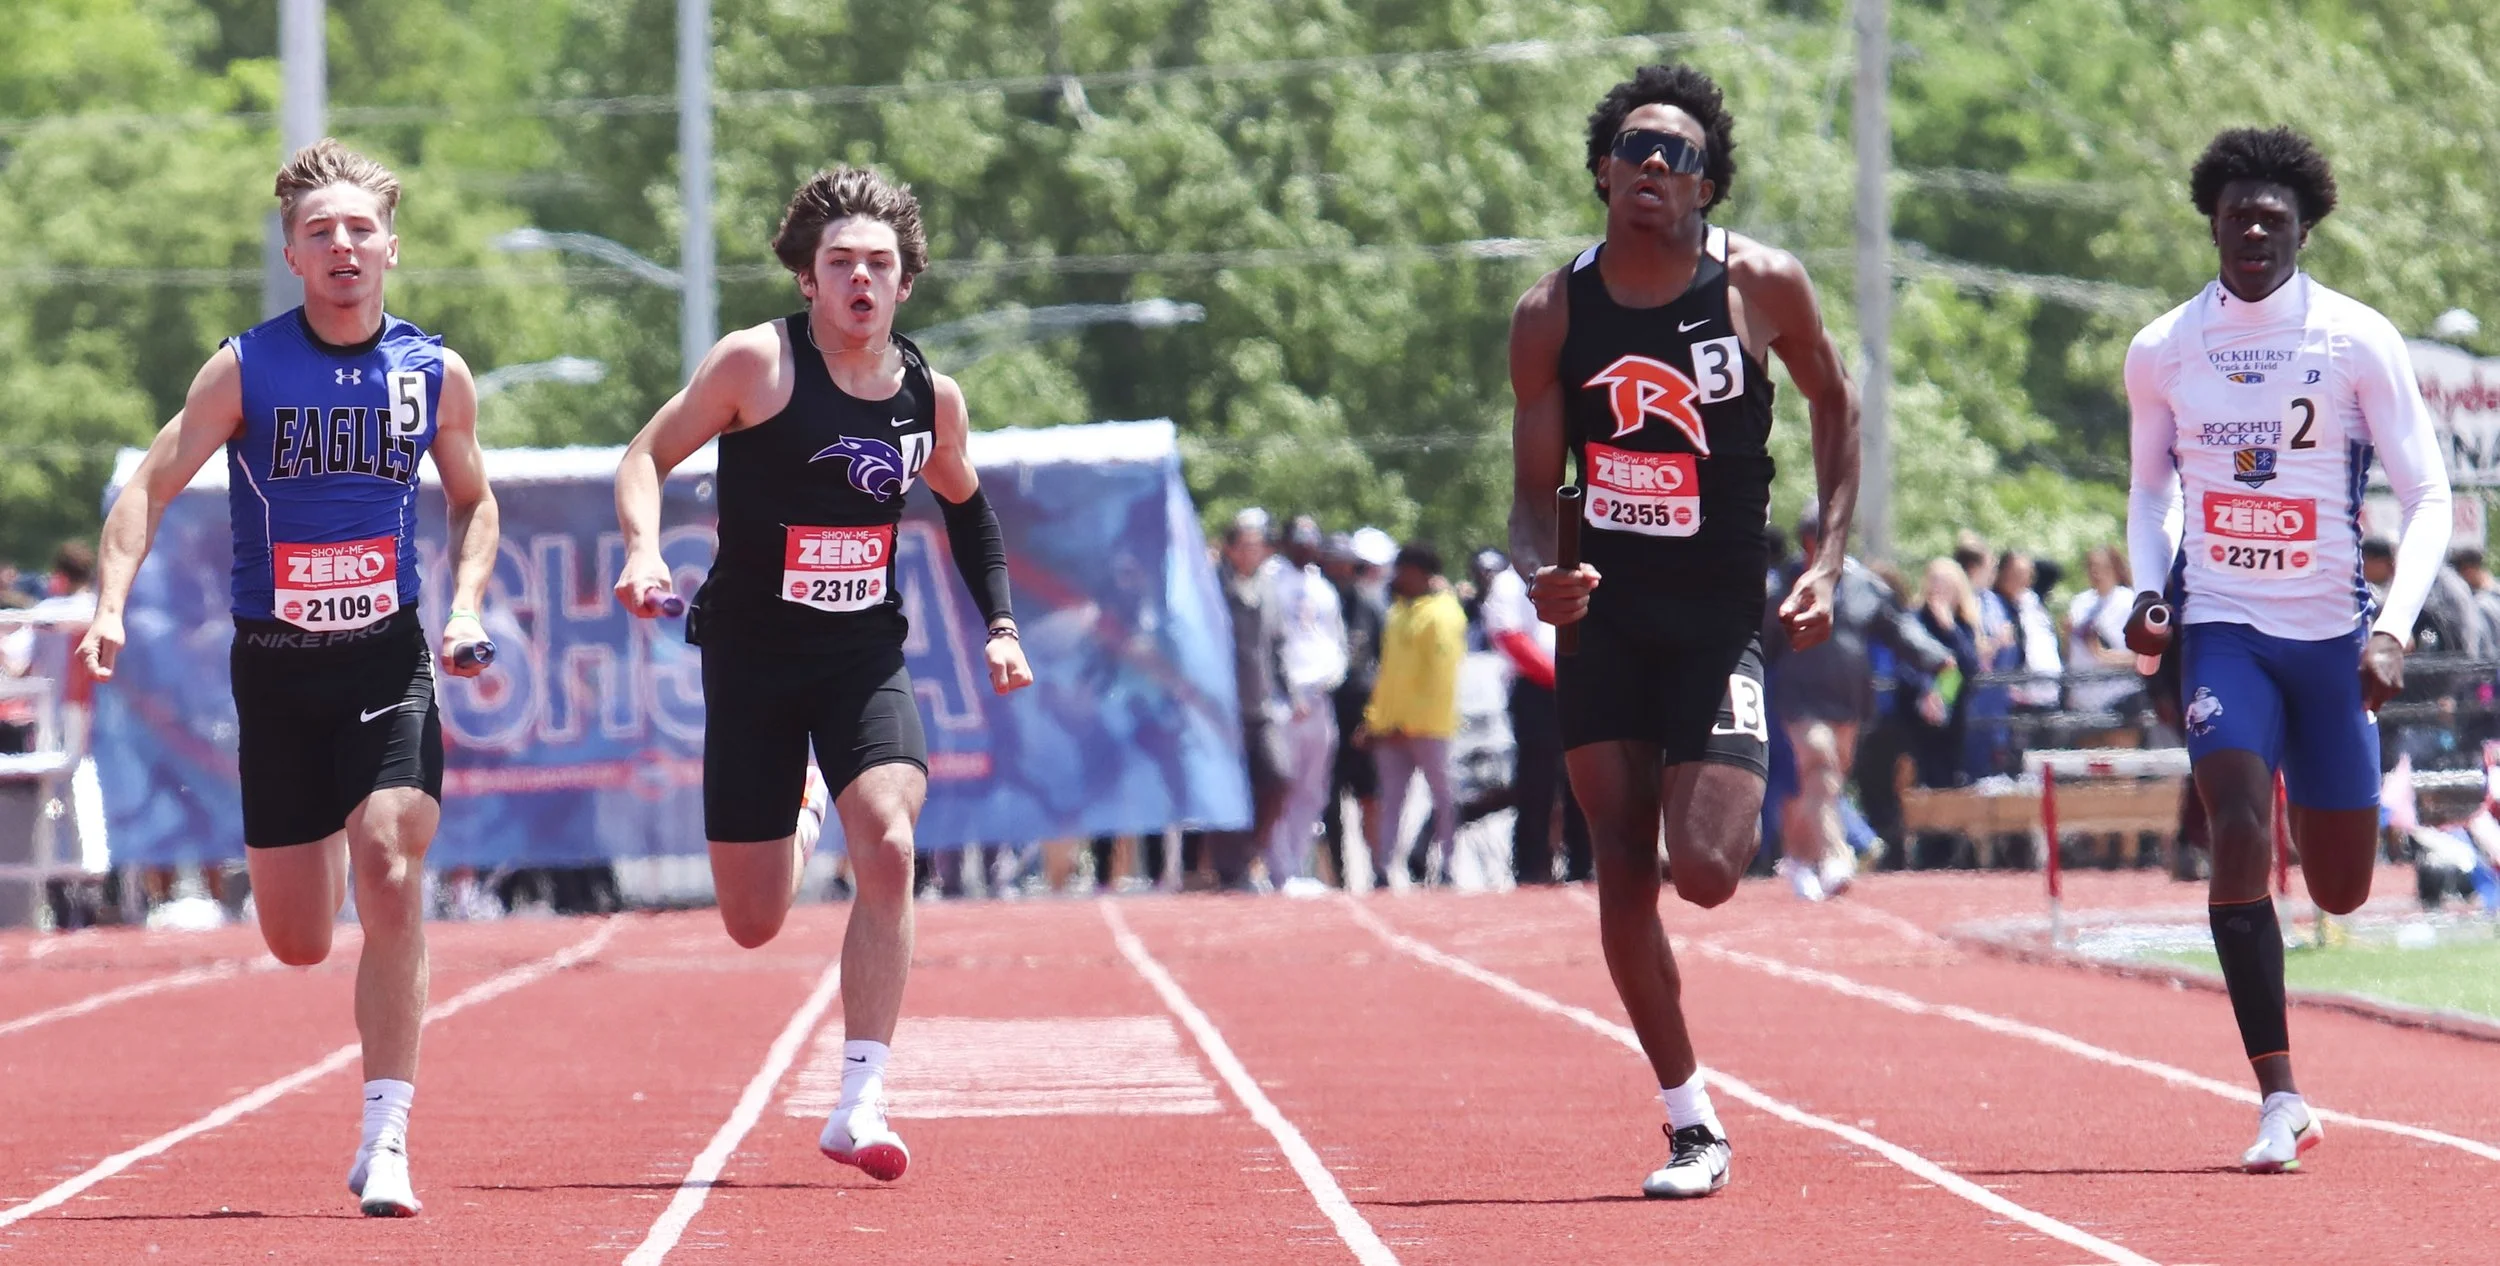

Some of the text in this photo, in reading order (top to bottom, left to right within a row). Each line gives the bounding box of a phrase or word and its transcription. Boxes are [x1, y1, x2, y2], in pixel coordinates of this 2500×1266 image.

[2209, 350, 2294, 364] OCKHURST
[2254, 362, 2278, 371] Field
[1702, 343, 1733, 399] 3
[398, 376, 420, 432] 5
[2290, 397, 2317, 450] 2
[267, 406, 417, 485] EAGLES
[2196, 433, 2249, 446] TRACK
[2254, 434, 2266, 445] &
[1611, 451, 1659, 466] SHOW-ME
[1595, 456, 1684, 490] ZERO
[1610, 500, 1670, 526] 2355
[2231, 499, 2283, 511] SHOW-ME
[2213, 505, 2304, 535] ZERO
[821, 530, 869, 540] SHOW-ME
[311, 544, 364, 558] SHOW-ME
[797, 538, 883, 565] ZERO
[2228, 546, 2285, 570] 2371
[287, 551, 385, 583] ZERO
[811, 579, 867, 603] 2318
[306, 594, 371, 622] 2109
[248, 632, 325, 649] NIKE
[1741, 681, 1759, 731] 3
